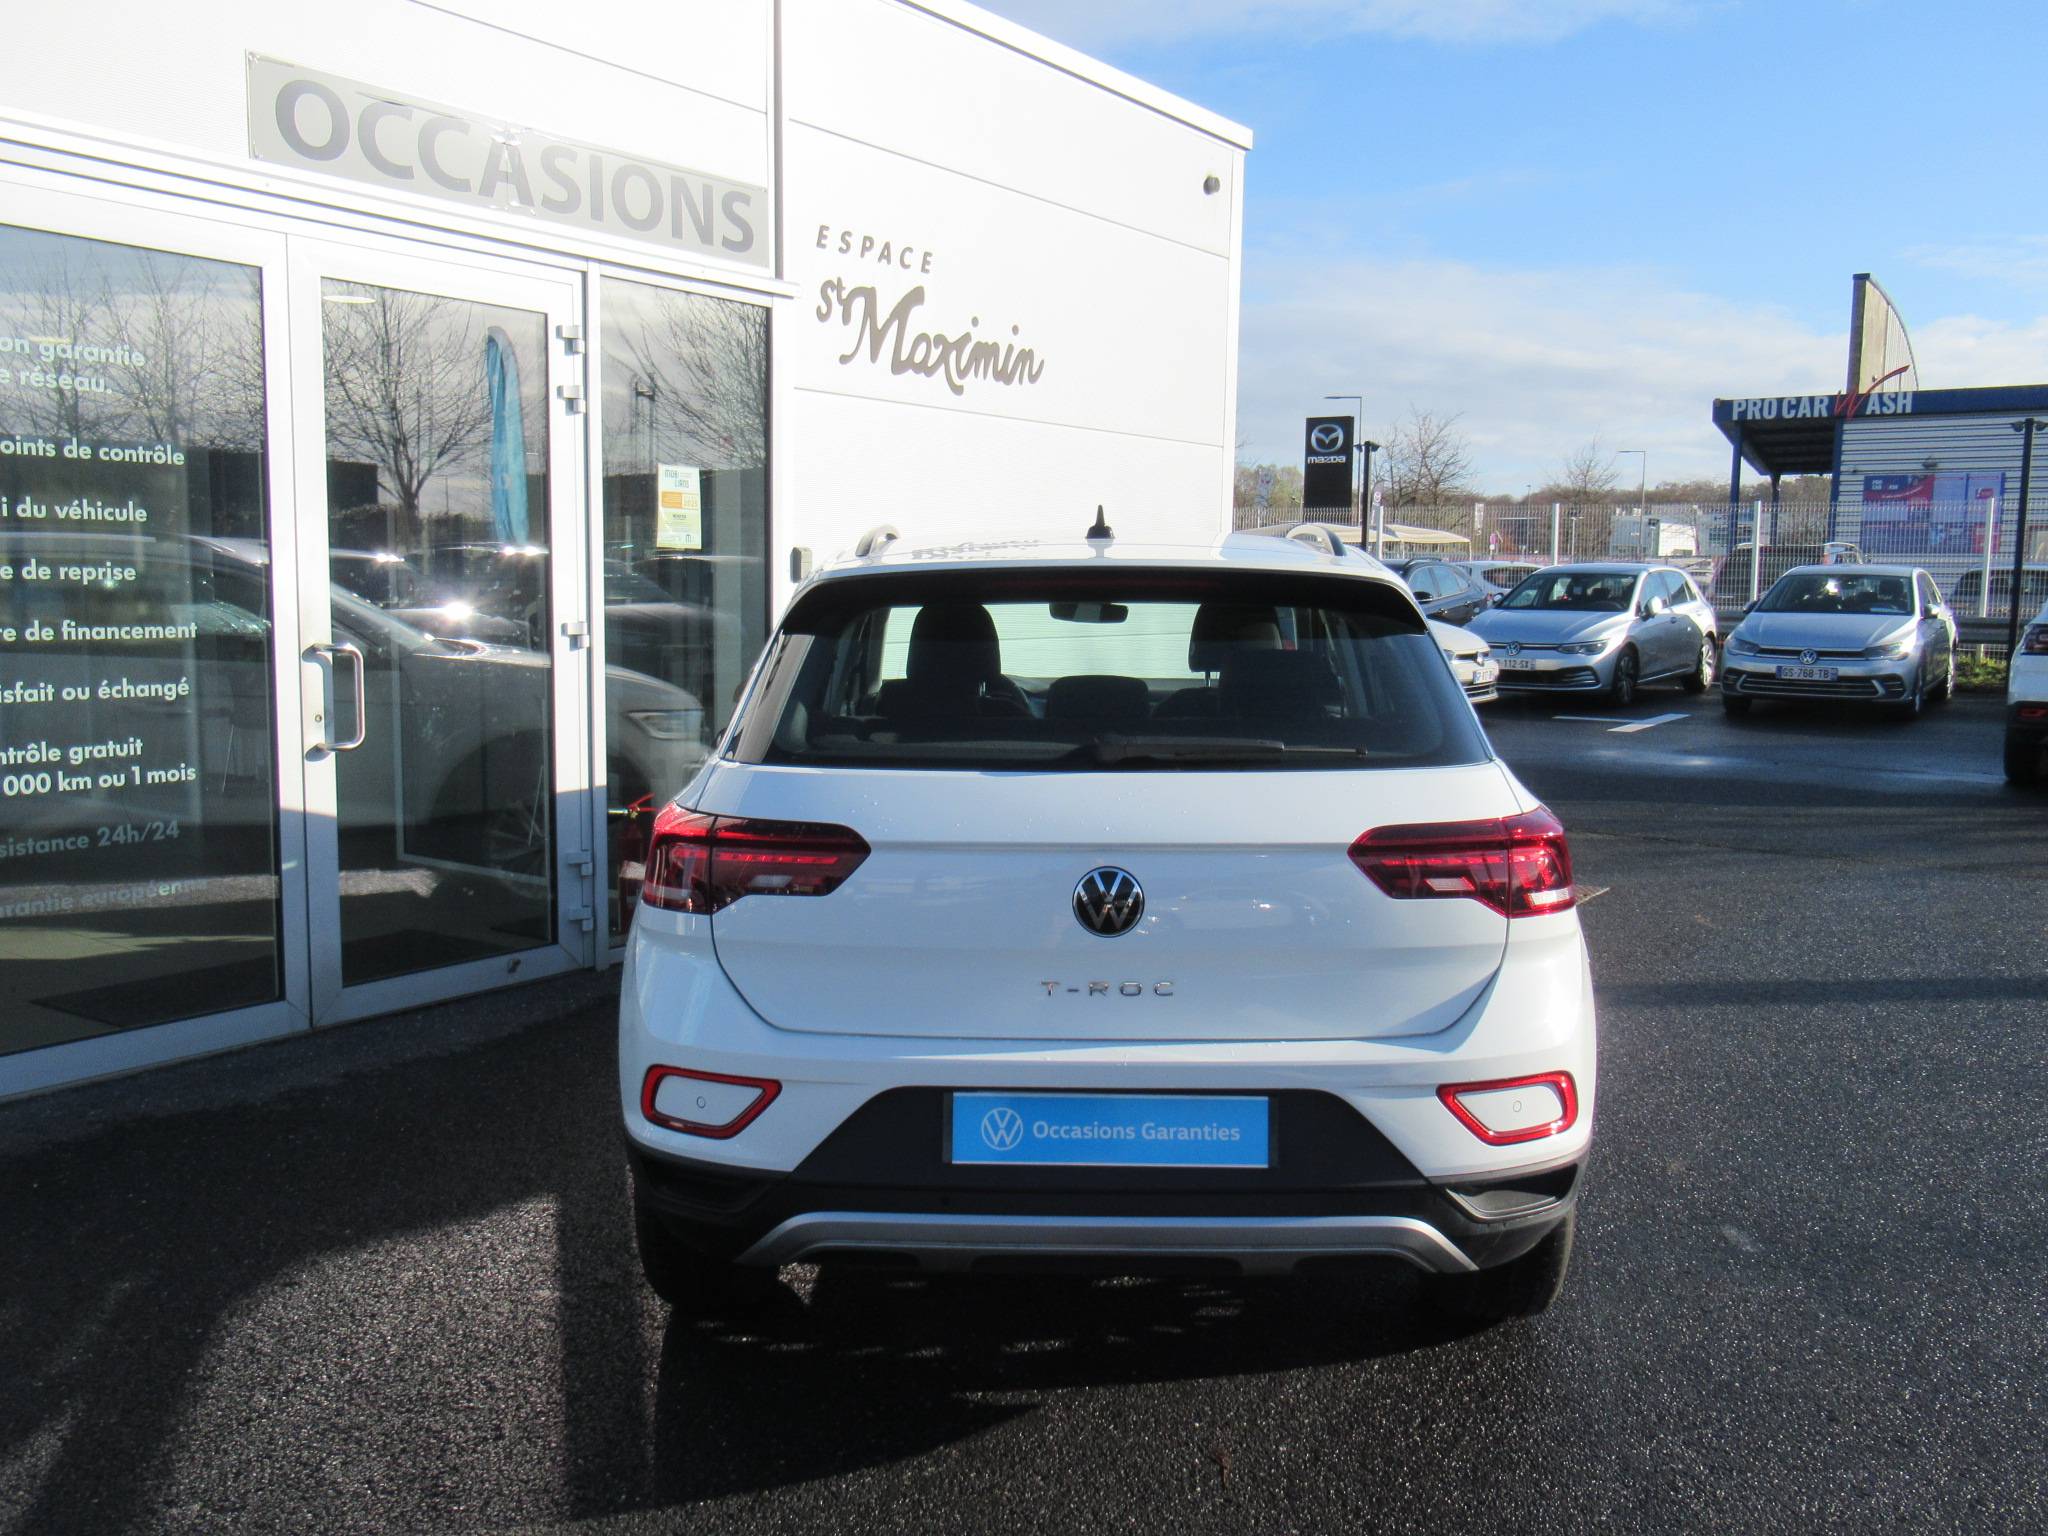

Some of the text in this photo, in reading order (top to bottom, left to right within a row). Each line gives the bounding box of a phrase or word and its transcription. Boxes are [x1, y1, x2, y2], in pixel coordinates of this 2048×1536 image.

[275, 79, 755, 253] OCCASIONS
[816, 224, 933, 274] ESPACE
[839, 285, 1045, 396] Maximin
[39, 342, 146, 367] garantie
[20, 365, 112, 394] réseau.
[1732, 398, 1777, 421] PRO
[1781, 395, 1828, 420] CAR
[0, 435, 185, 466] oints de contrôle
[17, 497, 47, 518] du
[55, 498, 148, 522] véhicule
[21, 559, 51, 581] de
[60, 562, 137, 585] reprise
[25, 619, 55, 642] de
[62, 619, 198, 641] financement
[62, 686, 91, 701] ou
[98, 677, 190, 701] échangé
[69, 737, 144, 767] gratuit
[3, 763, 197, 796] 000 km ou 1 mois
[97, 820, 181, 847] 24h/24
[1041, 981, 1175, 997] T-ROC
[1033, 1120, 1136, 1141] Occasions
[1142, 1122, 1241, 1142] Garanties
